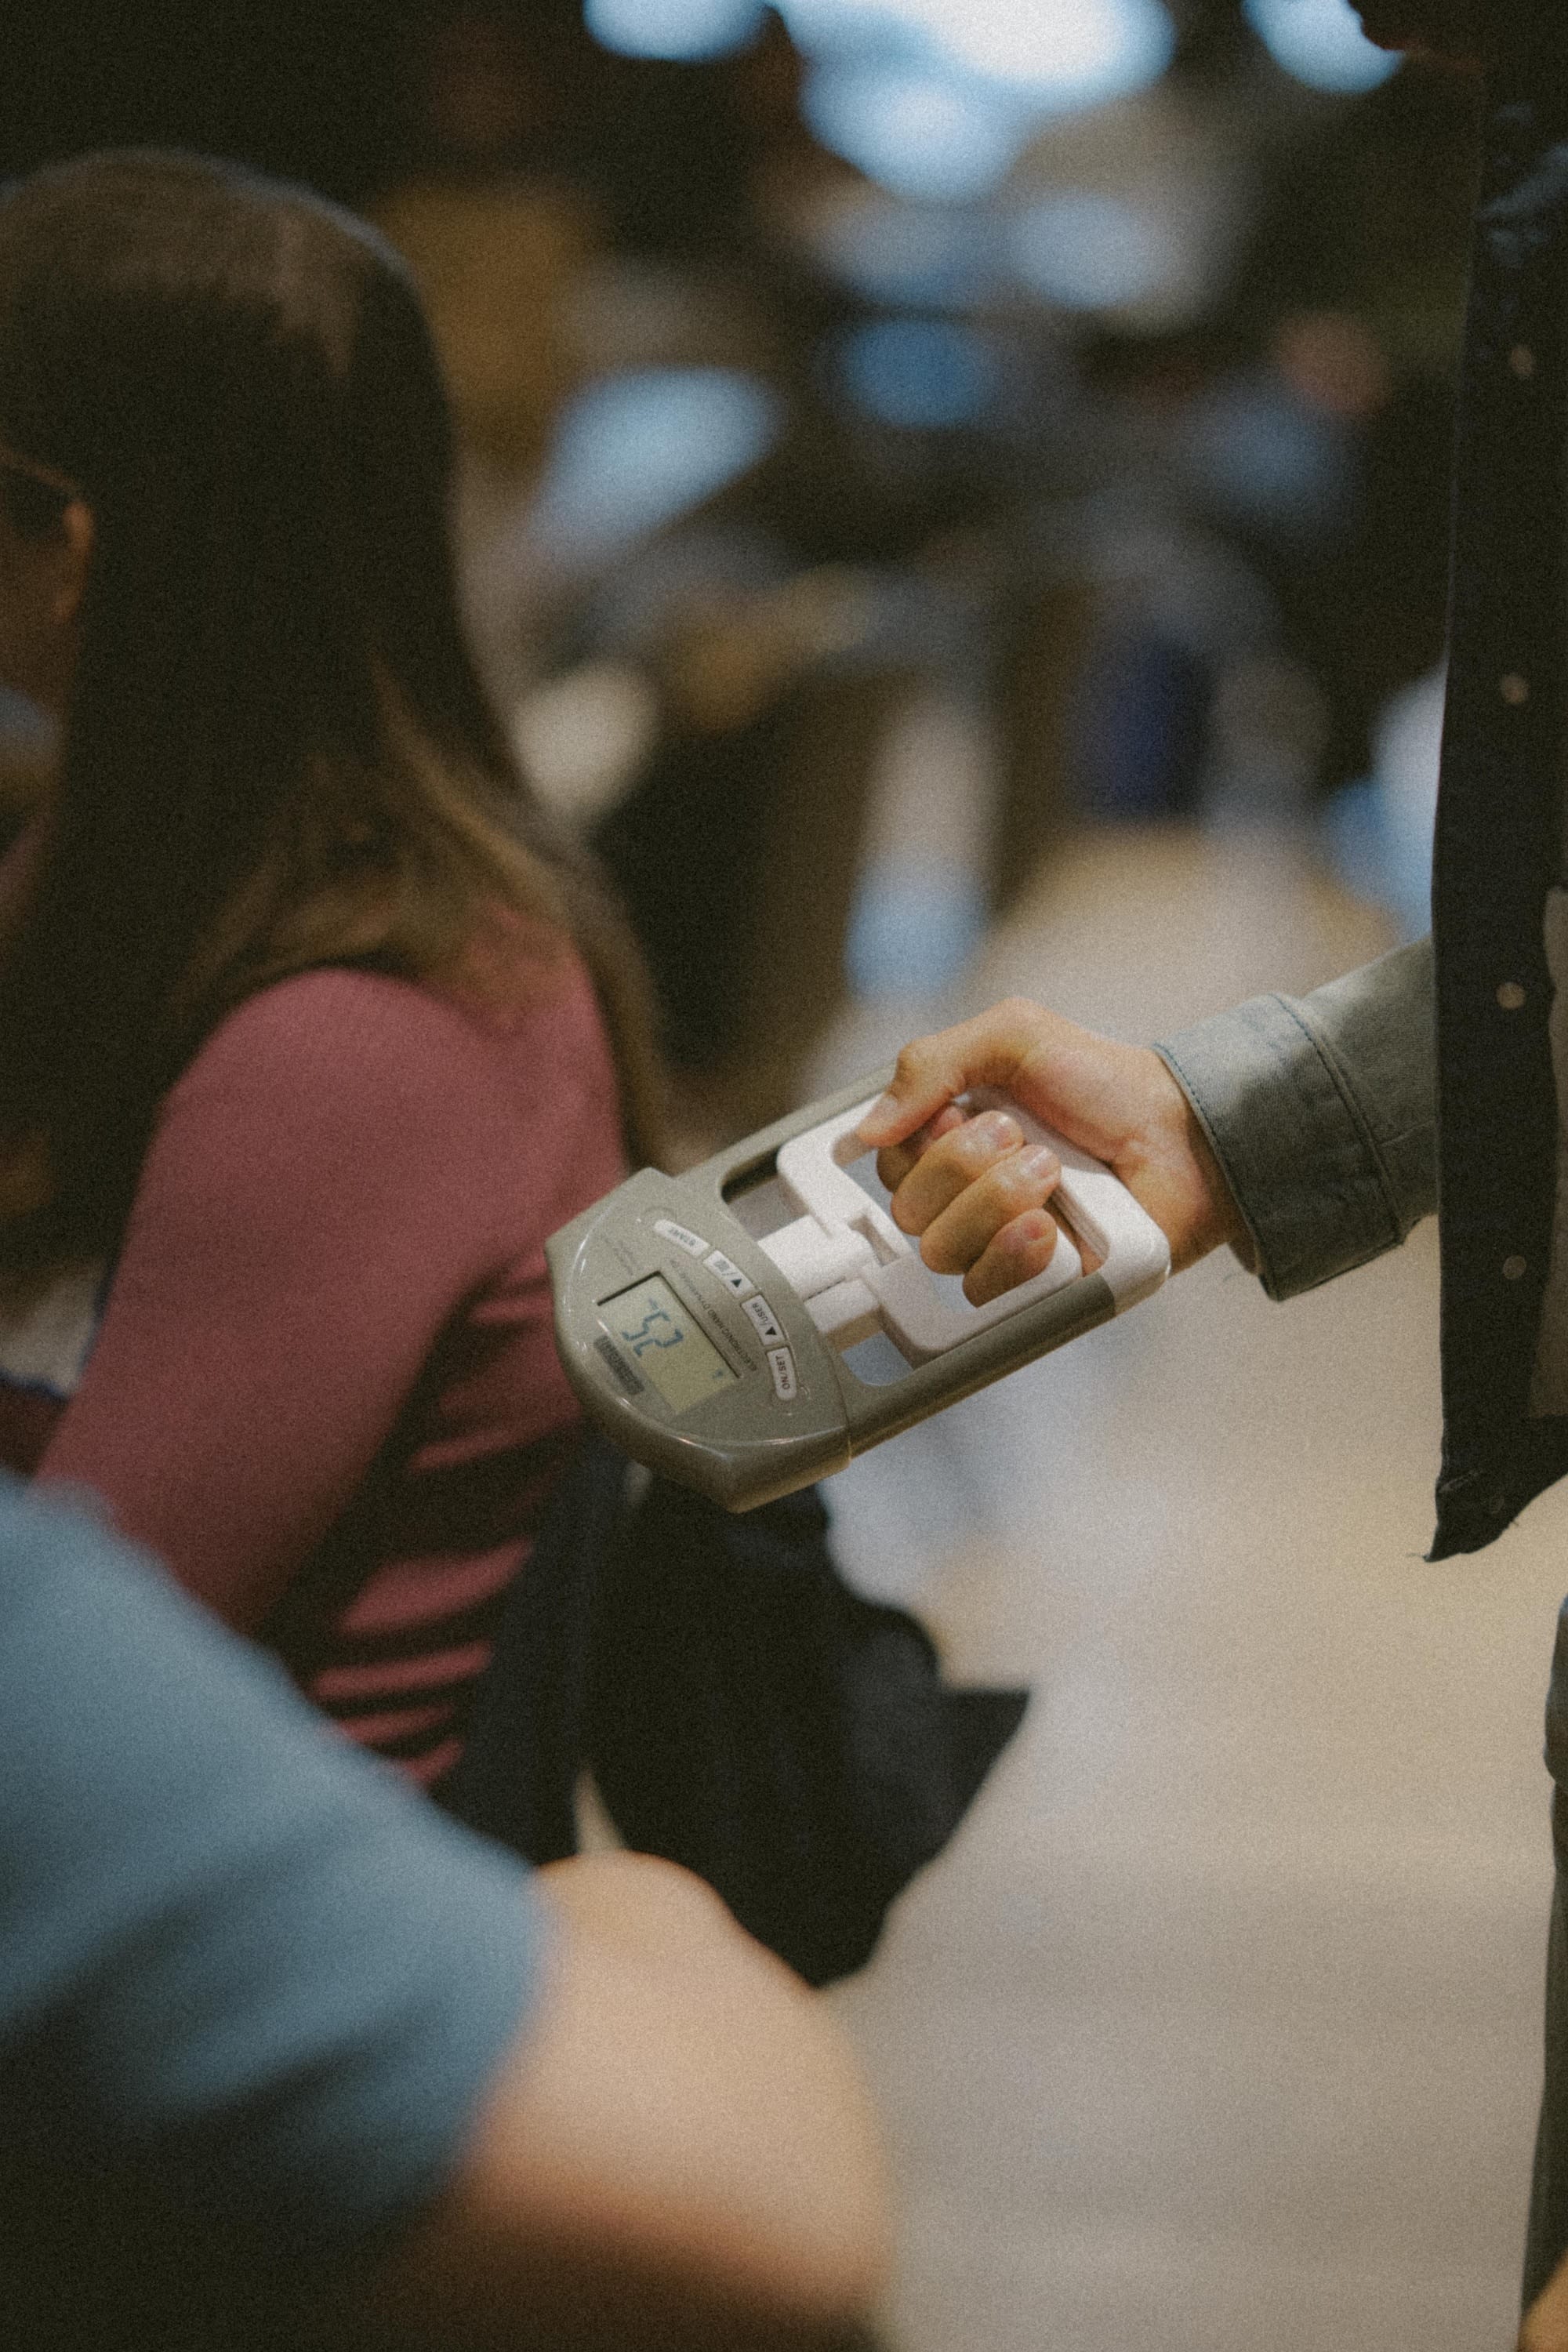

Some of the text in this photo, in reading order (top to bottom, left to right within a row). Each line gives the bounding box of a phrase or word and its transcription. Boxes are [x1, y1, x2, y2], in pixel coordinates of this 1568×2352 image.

[668, 1225, 696, 1246] START
[720, 1326, 758, 1372] ELECTRONIC
[774, 1354, 791, 1389] ON/SET
